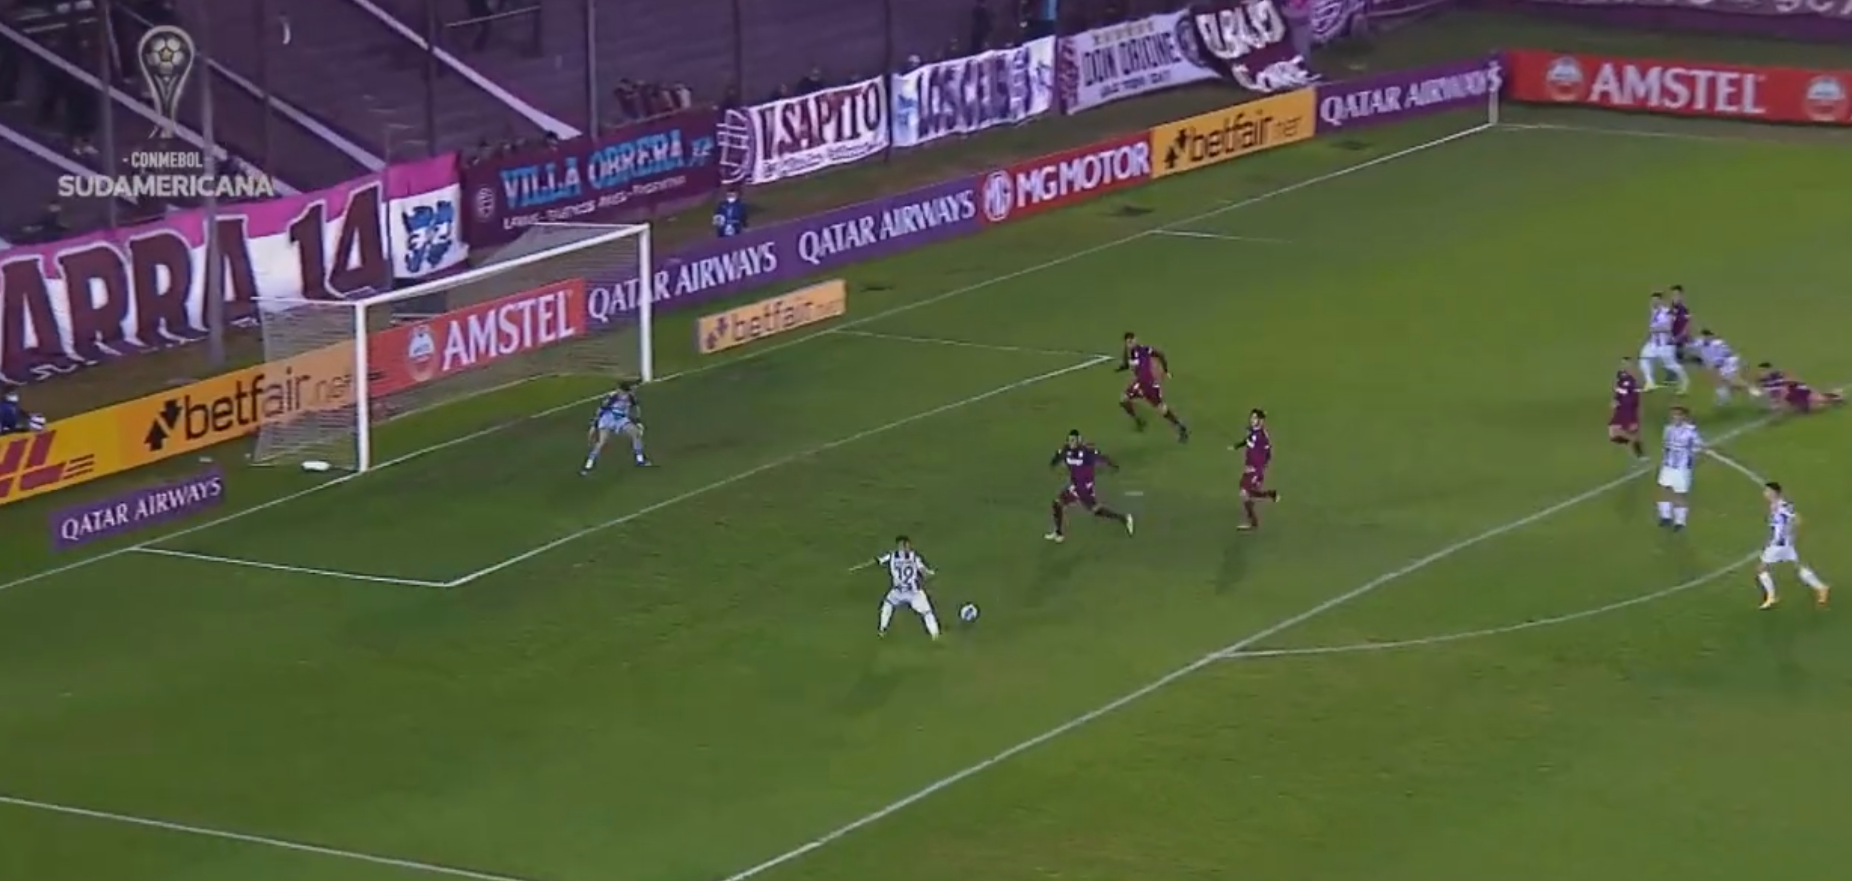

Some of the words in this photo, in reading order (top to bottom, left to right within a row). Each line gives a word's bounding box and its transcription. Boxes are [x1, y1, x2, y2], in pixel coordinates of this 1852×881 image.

[1320, 86, 1402, 125] QATAR
[1587, 63, 1767, 114] AMSTEL
[500, 157, 582, 208] VILLA
[1059, 141, 1151, 196] MOTOR
[288, 181, 393, 301] 14
[674, 242, 778, 298] AIRWAYS
[799, 212, 876, 264] QATAR
[878, 190, 977, 239] AIRWAYS
[443, 290, 577, 371] AMSTEL
[61, 503, 129, 540] QATAR
[134, 477, 221, 521] AIRWAYS
[895, 566, 914, 586] 19
